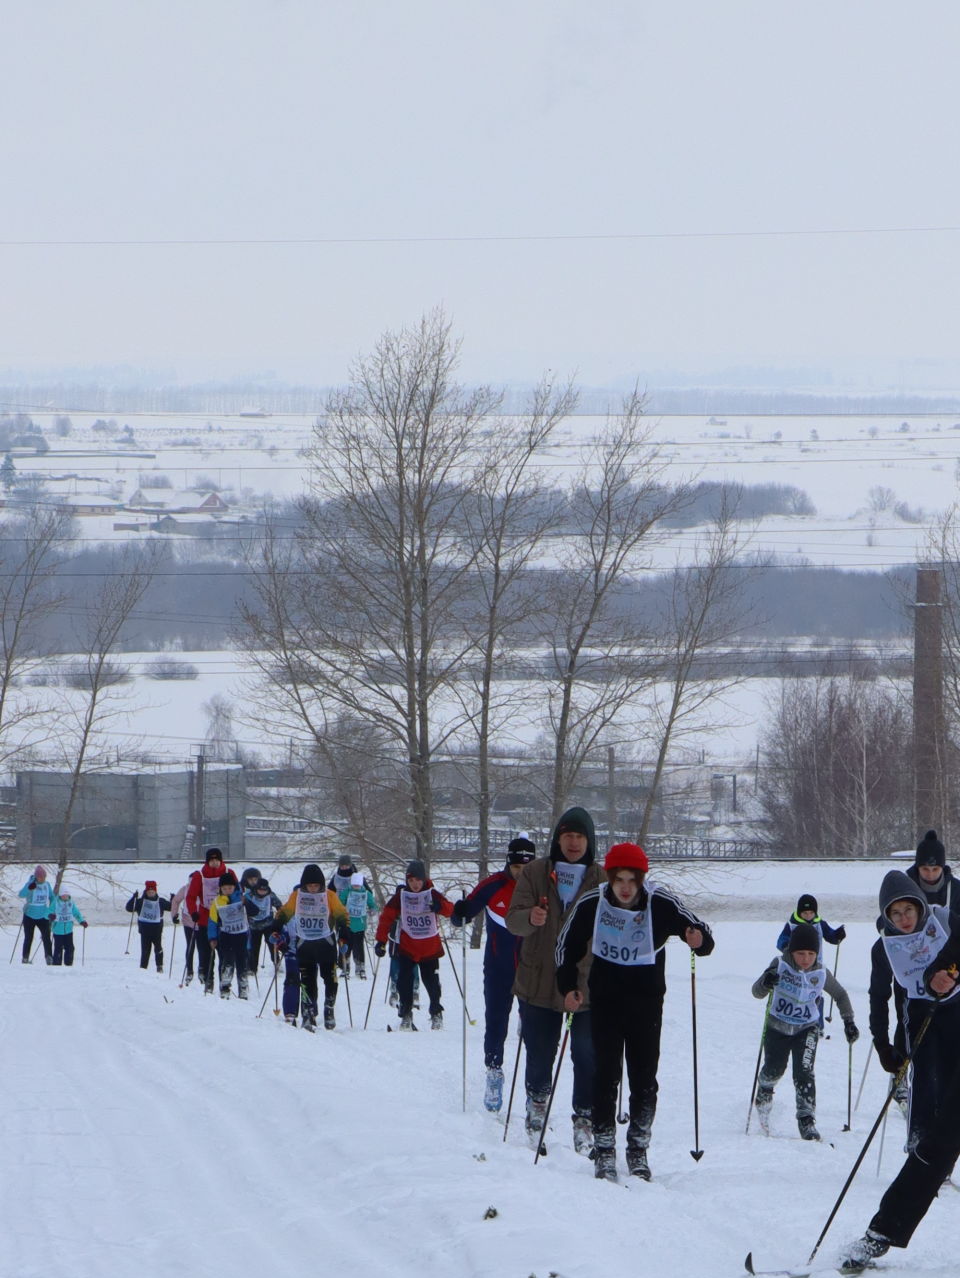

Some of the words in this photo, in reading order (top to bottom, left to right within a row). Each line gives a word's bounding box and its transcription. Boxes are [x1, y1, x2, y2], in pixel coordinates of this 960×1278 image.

[300, 917, 325, 929] 9076
[407, 915, 432, 928] 9036
[600, 940, 640, 962] 3501
[775, 998, 812, 1020] 9024
